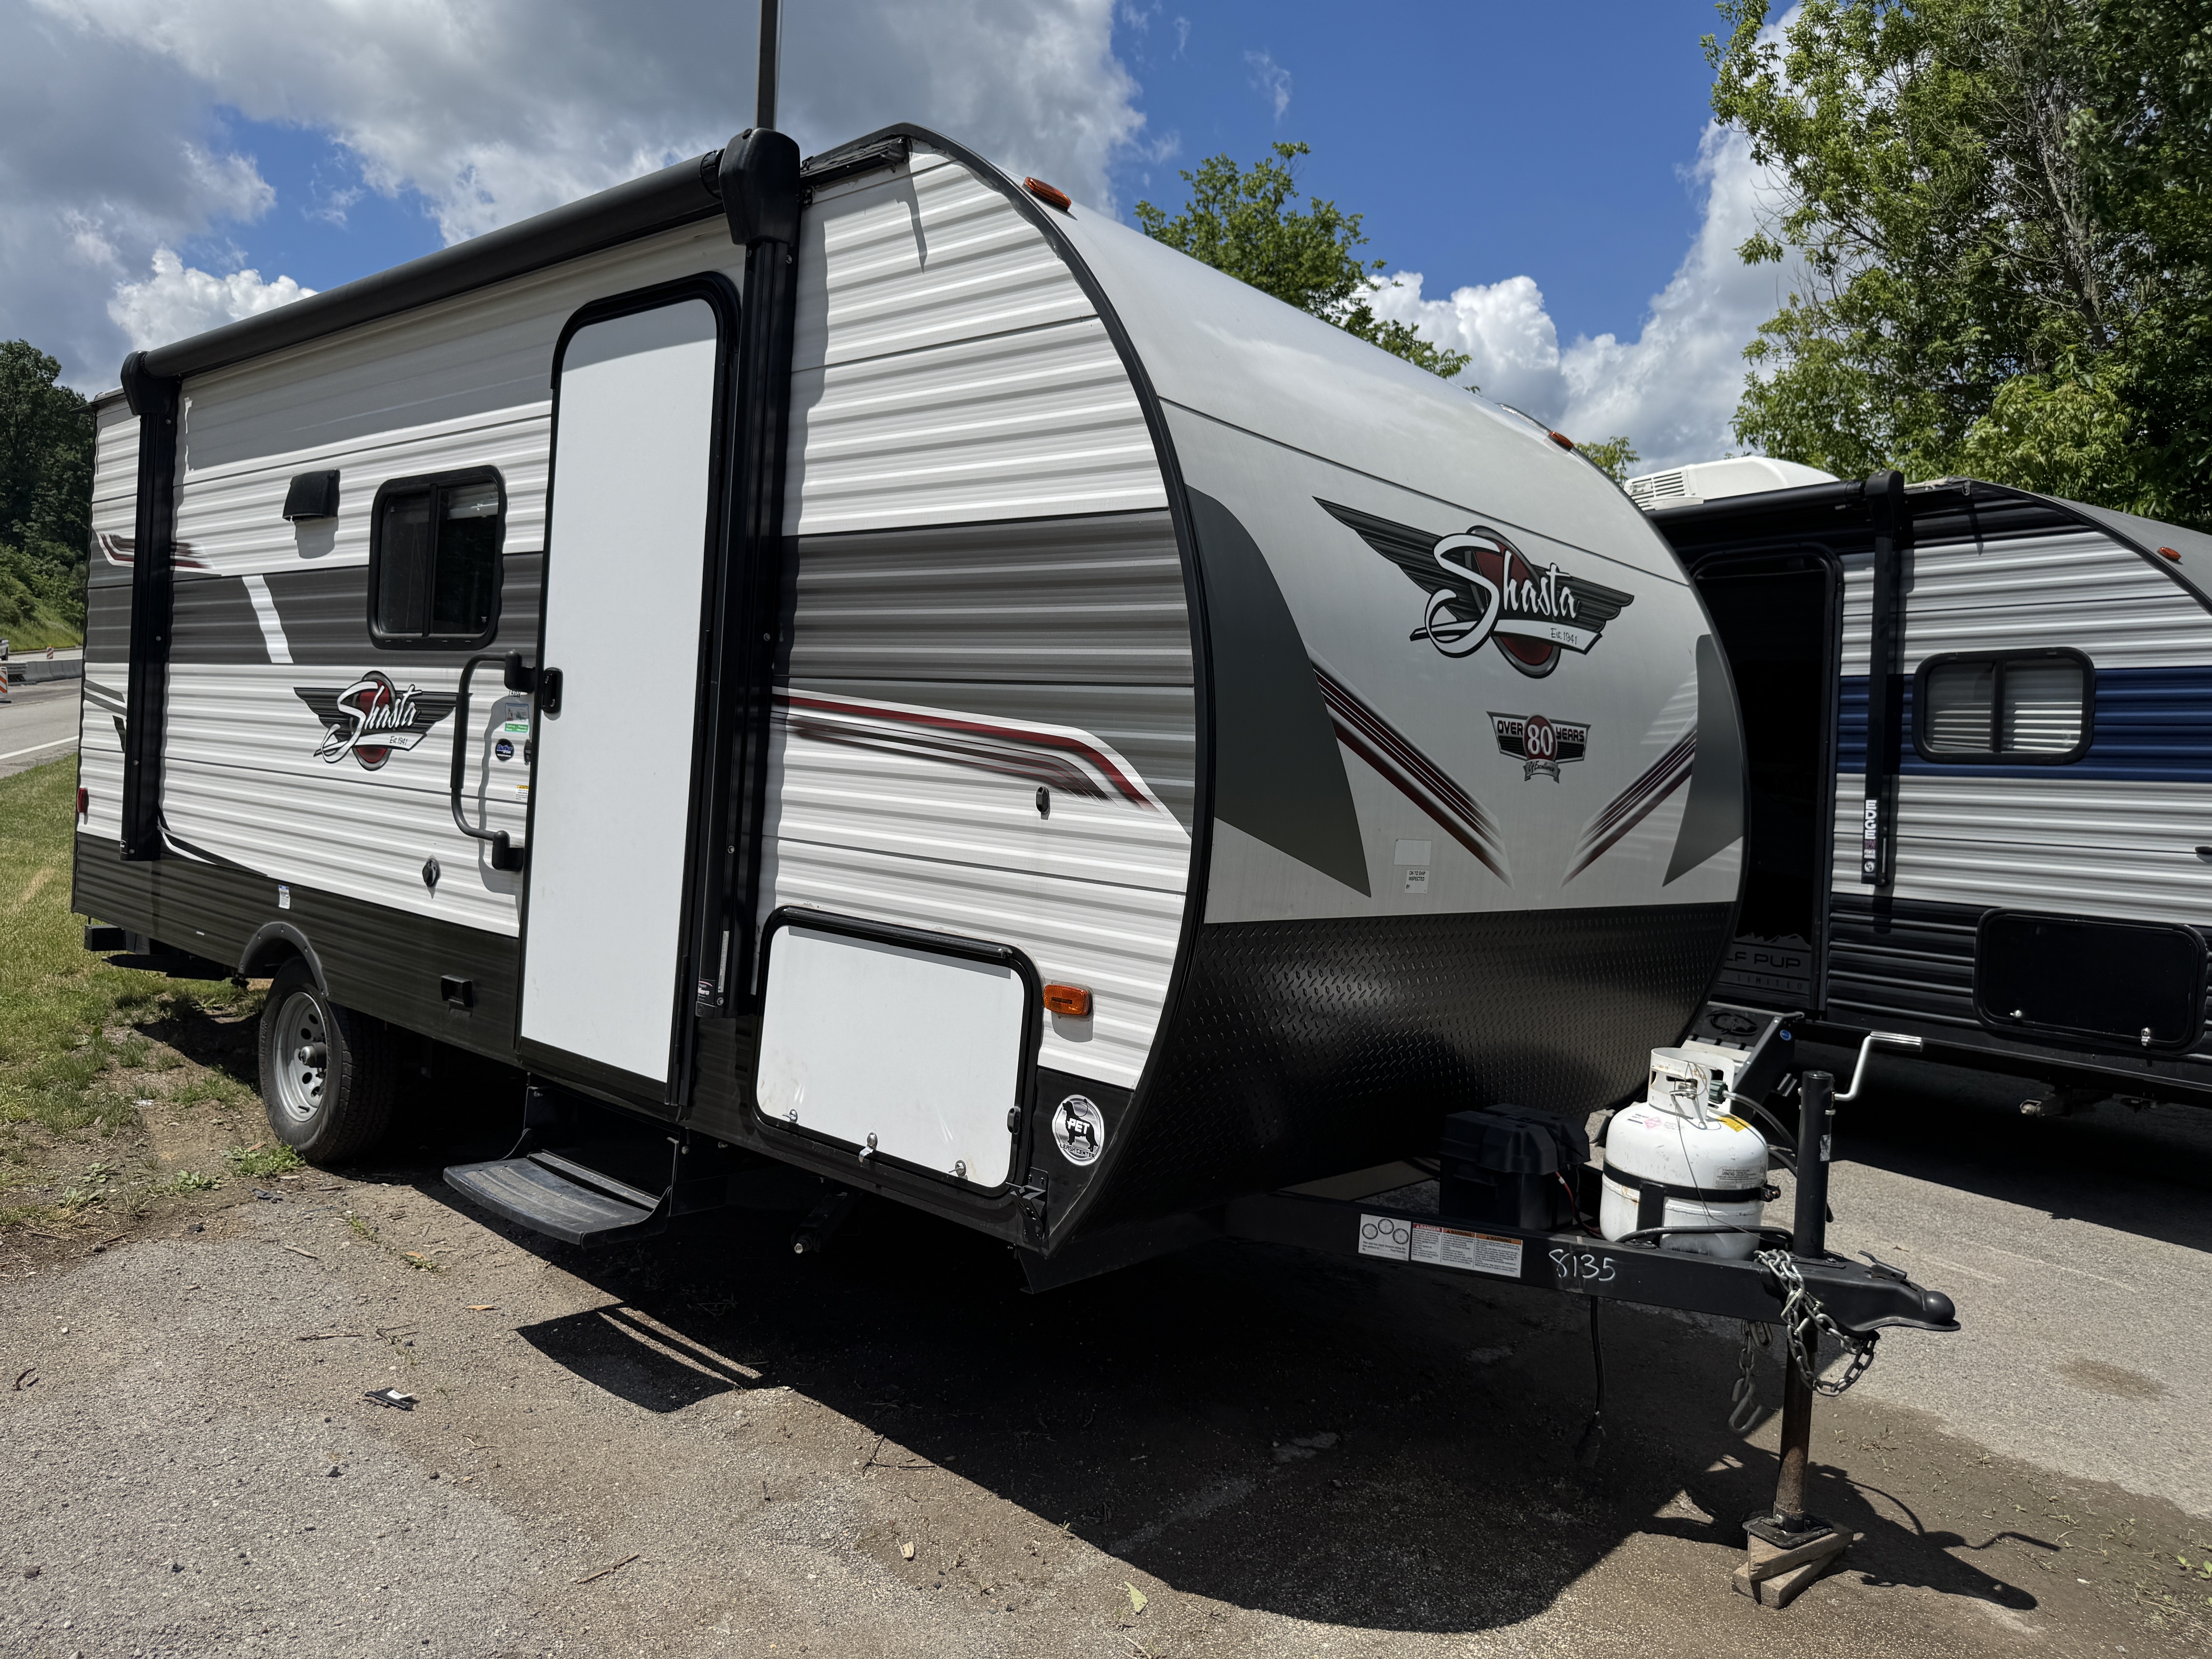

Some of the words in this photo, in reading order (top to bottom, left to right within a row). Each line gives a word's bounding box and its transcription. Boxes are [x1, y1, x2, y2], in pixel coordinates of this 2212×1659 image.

[1425, 533, 1579, 658] Shasta
[321, 680, 422, 763] Shasta
[1497, 720, 1523, 735] OVER
[1527, 724, 1553, 756] 80
[1556, 726, 1584, 742] YEARS
[1864, 799, 1877, 840] EDGE
[1754, 953, 1801, 968] PUP
[1738, 975, 1802, 990] LIMITED
[1067, 1118, 1090, 1134] PET
[1060, 1143, 1075, 1152] LEASH
[1076, 1149, 1095, 1159] CENTER
[1548, 1249, 1616, 1281] 8135
